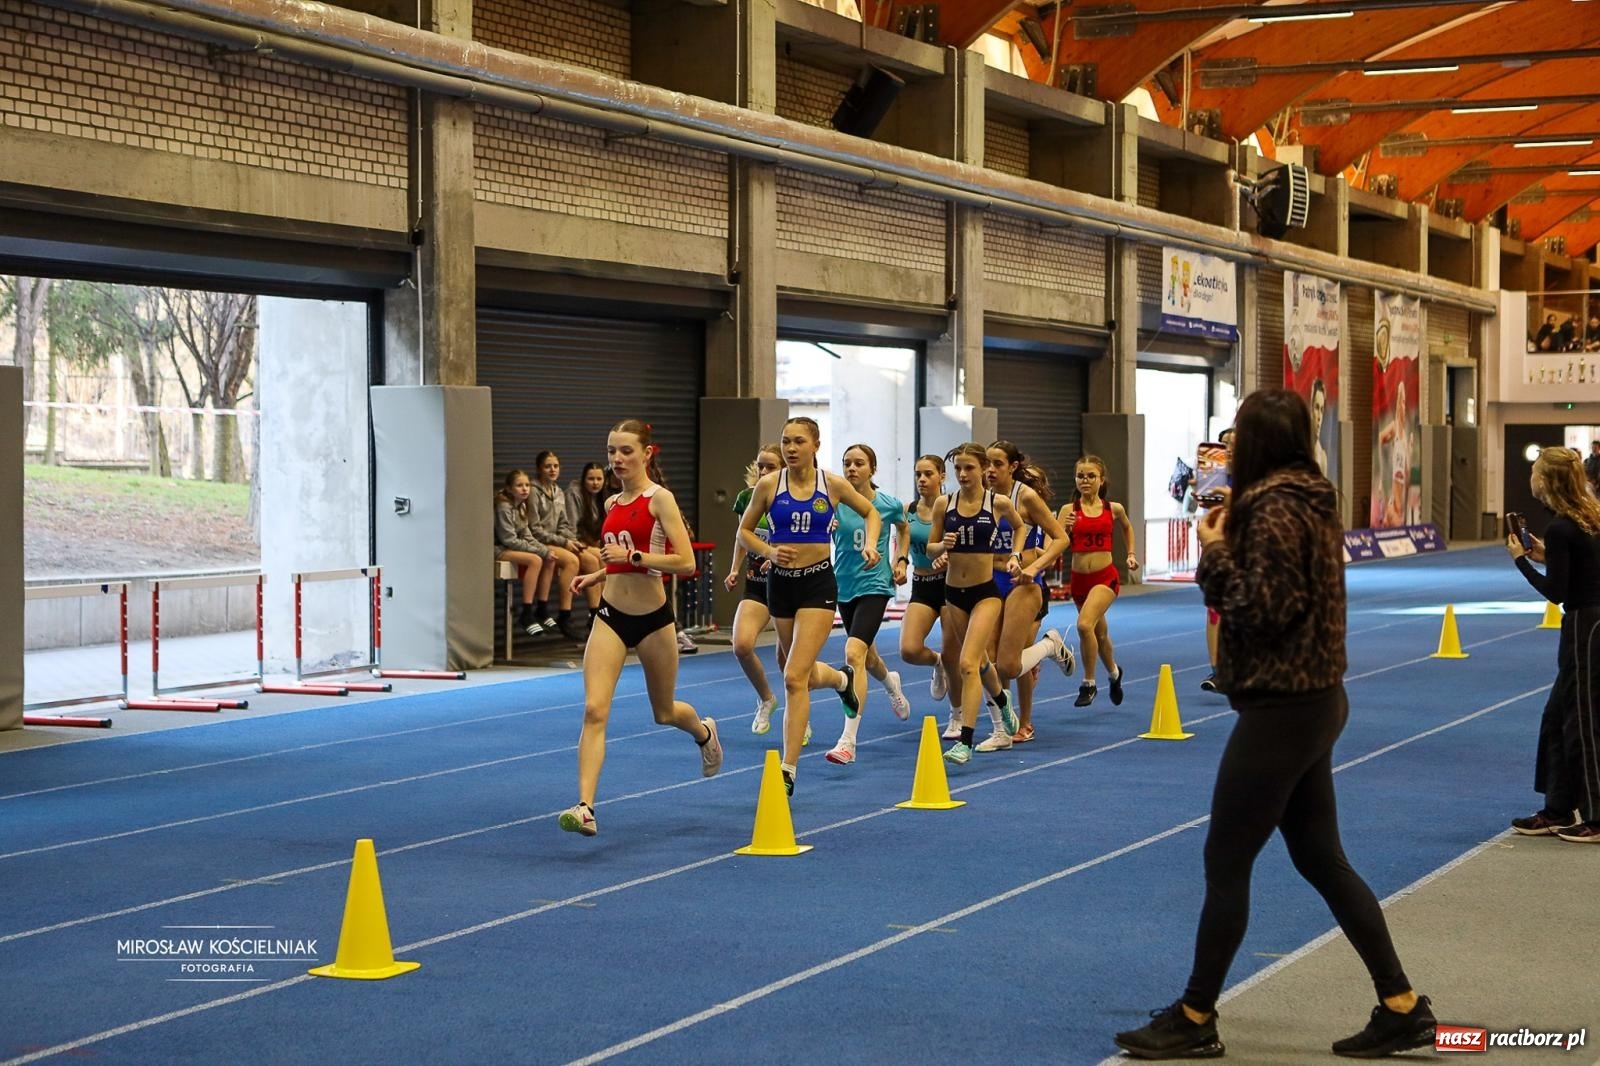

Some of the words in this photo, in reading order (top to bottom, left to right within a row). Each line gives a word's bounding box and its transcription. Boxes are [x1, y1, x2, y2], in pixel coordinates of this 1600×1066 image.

[790, 511, 811, 533] 30
[853, 528, 865, 552] 9
[958, 525, 974, 545] 11
[774, 567, 802, 578] NIKE
[803, 561, 830, 576] PRO
